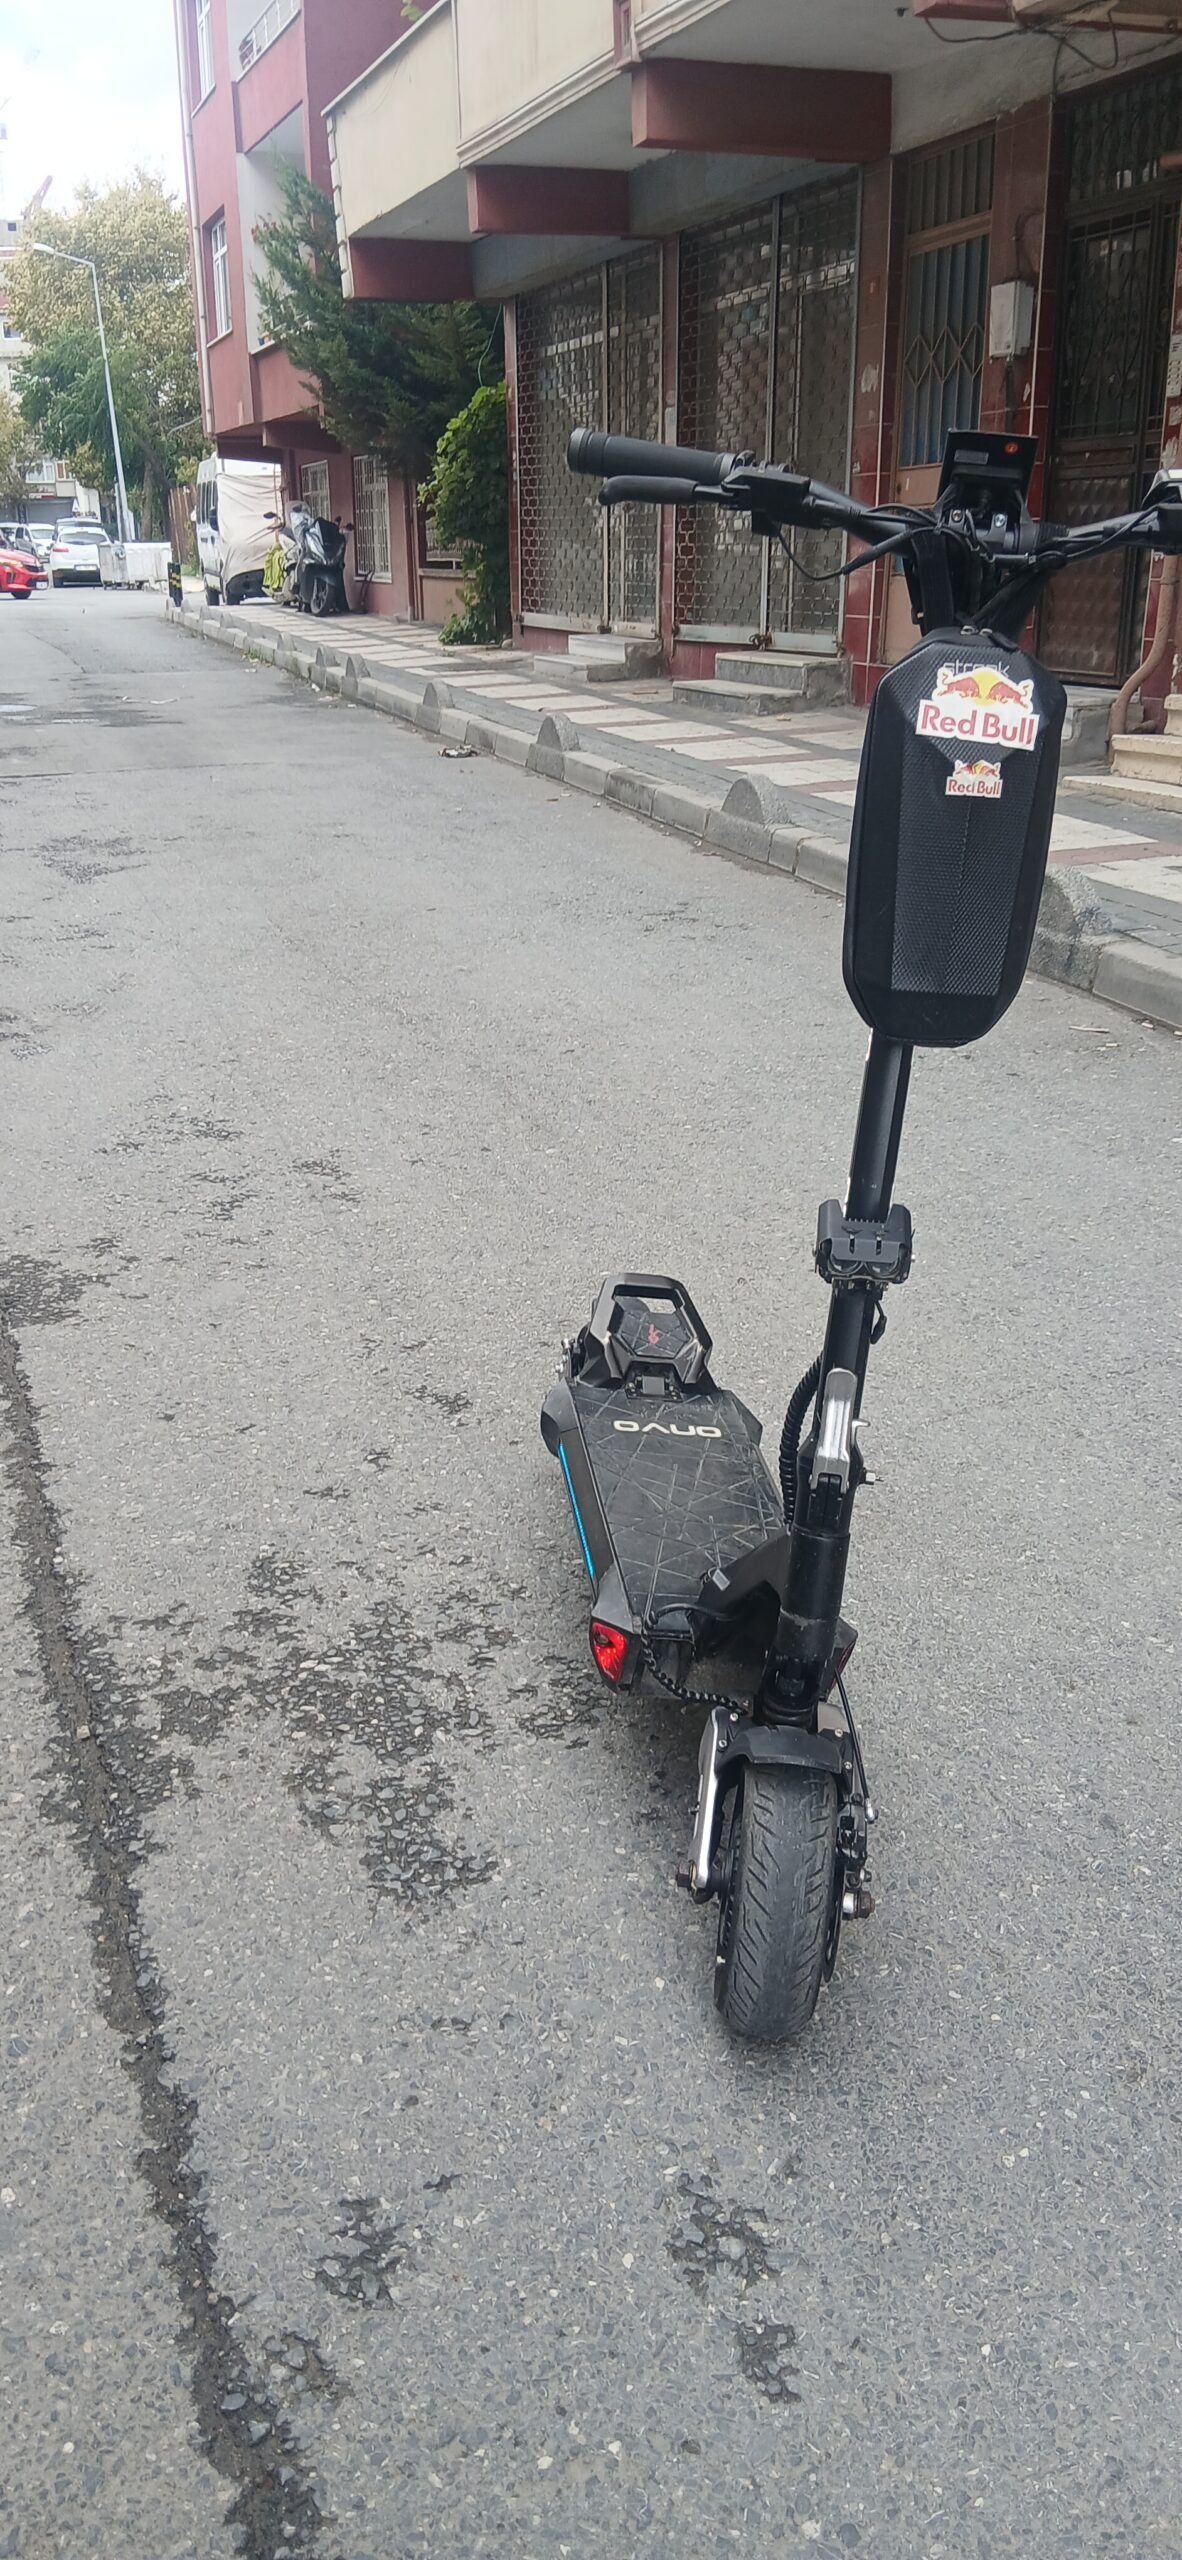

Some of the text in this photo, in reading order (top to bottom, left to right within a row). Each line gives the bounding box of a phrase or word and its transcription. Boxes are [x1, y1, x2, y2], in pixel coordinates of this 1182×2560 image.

[921, 705, 1034, 745] Red Bull
[948, 779, 1000, 795] Red Bull
